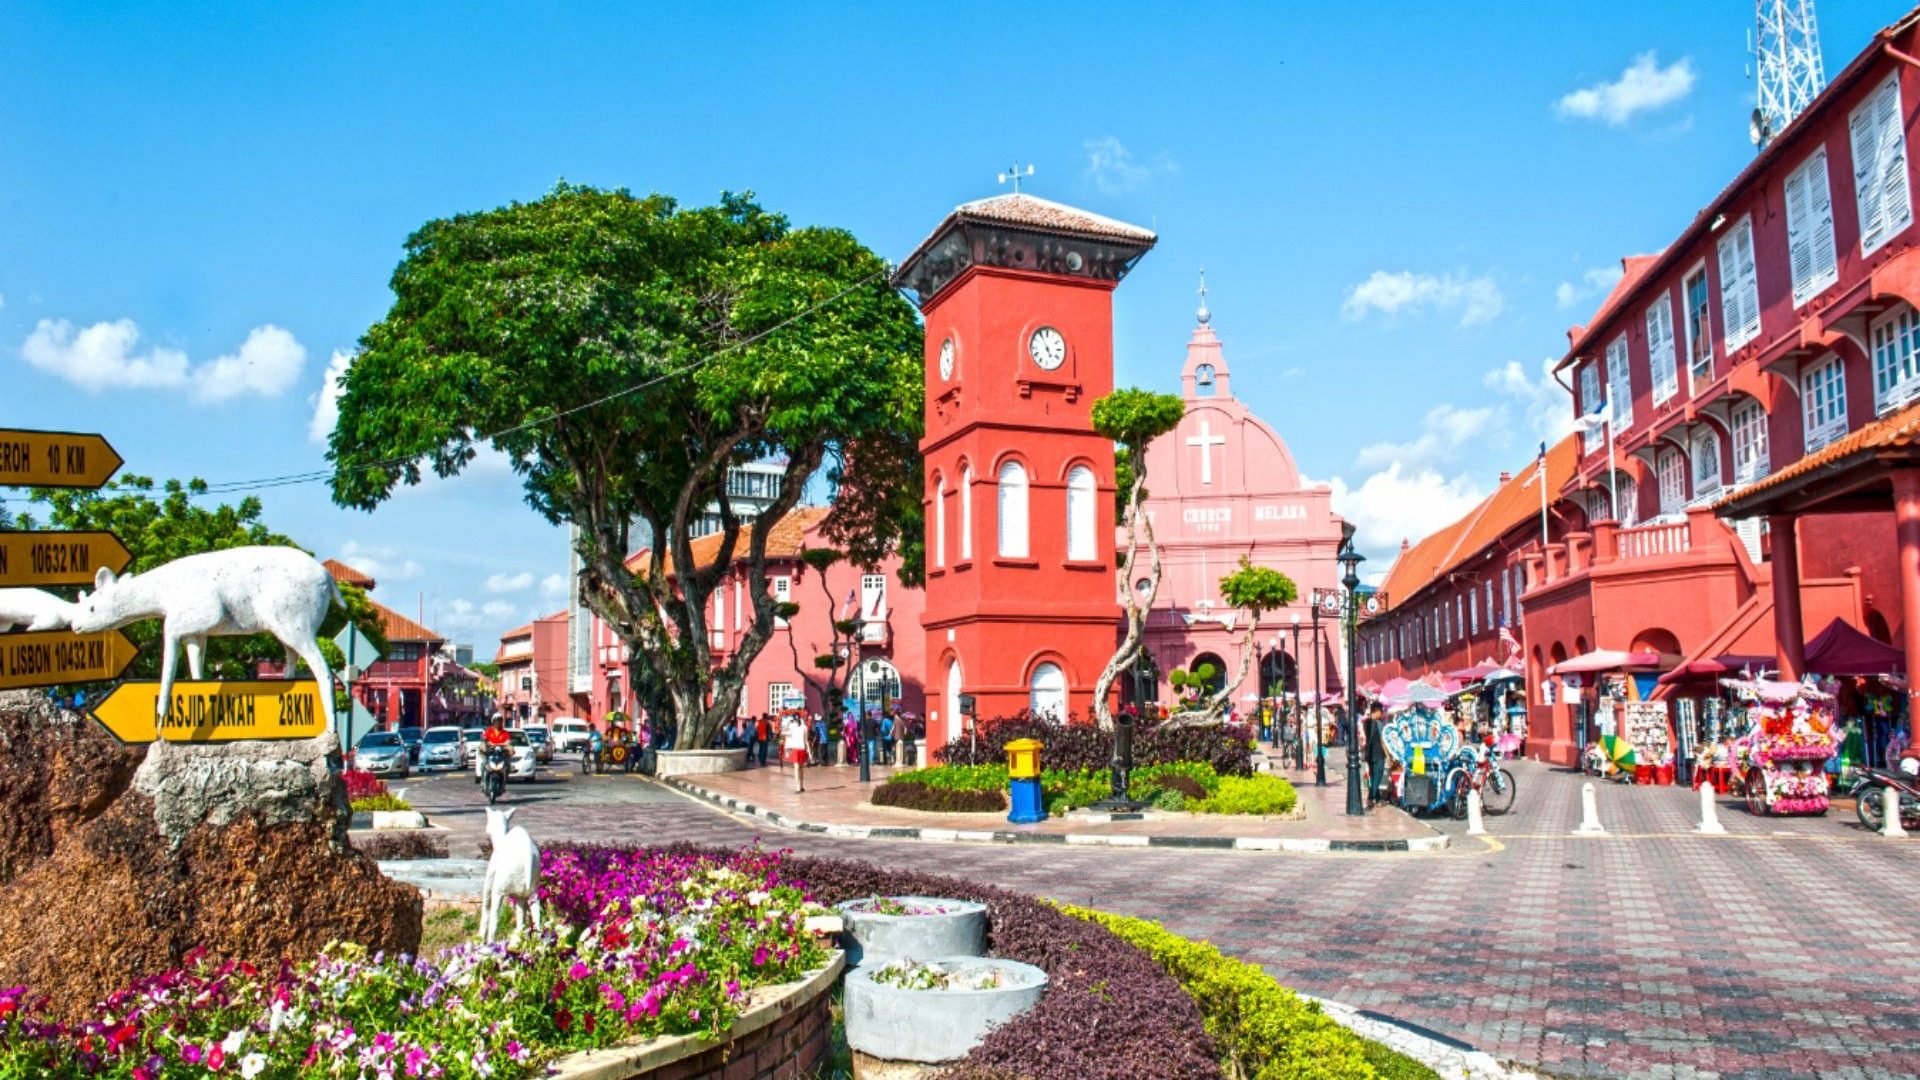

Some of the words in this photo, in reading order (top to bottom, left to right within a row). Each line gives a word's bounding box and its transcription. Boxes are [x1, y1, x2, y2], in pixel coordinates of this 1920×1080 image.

[48, 444, 60, 474] 10
[66, 445, 85, 474] KM
[1183, 507, 1232, 523] CHURCH
[1255, 505, 1307, 521] MELAKA
[31, 543, 67, 574] 10632
[70, 543, 89, 573] KM
[10, 643, 51, 676] LISBON
[55, 640, 86, 672] 10432
[88, 640, 104, 669] KM
[209, 693, 255, 727] TANAH
[278, 693, 315, 726] 28KM
